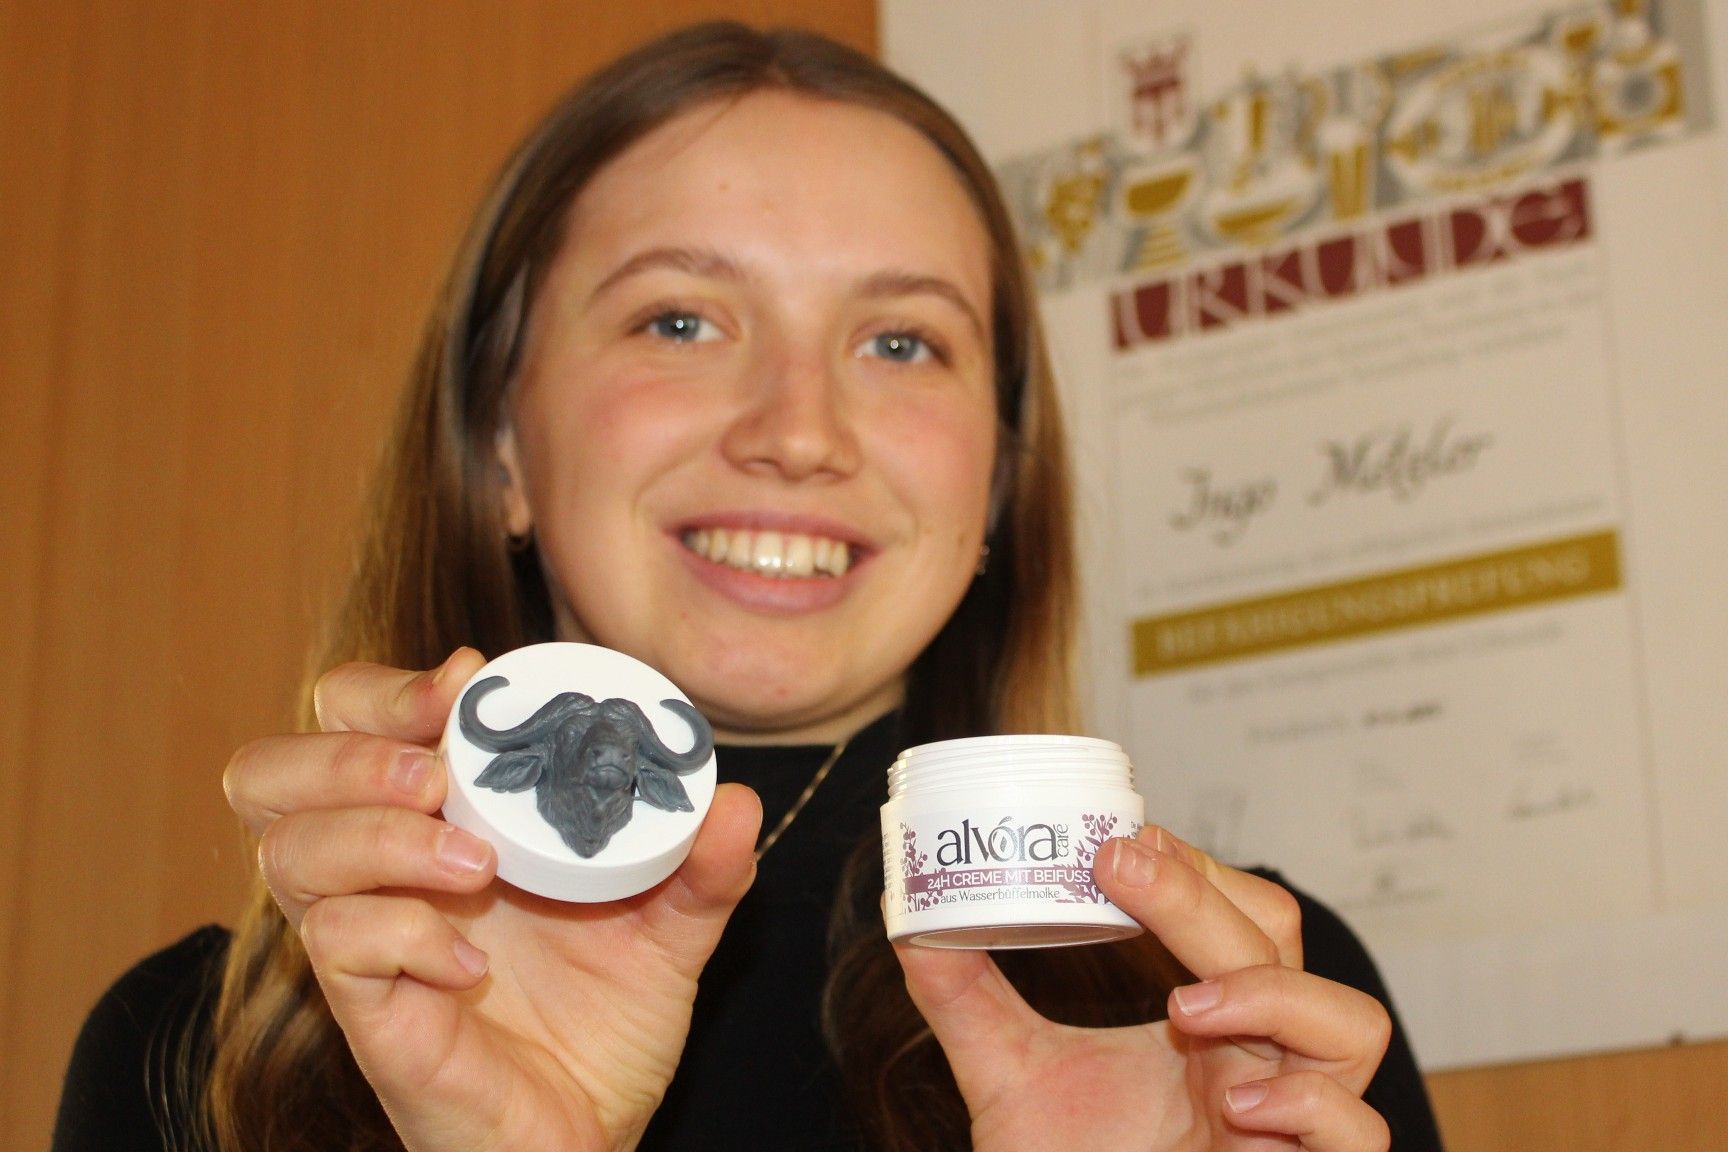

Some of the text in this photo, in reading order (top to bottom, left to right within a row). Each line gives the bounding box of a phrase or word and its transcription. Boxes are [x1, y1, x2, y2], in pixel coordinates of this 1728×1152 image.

[1053, 823, 1069, 858] care
[927, 869, 1091, 890] 24H CREME MIT BEIFUSS
[940, 888, 1060, 904] aus Wasserbüffelmolke
